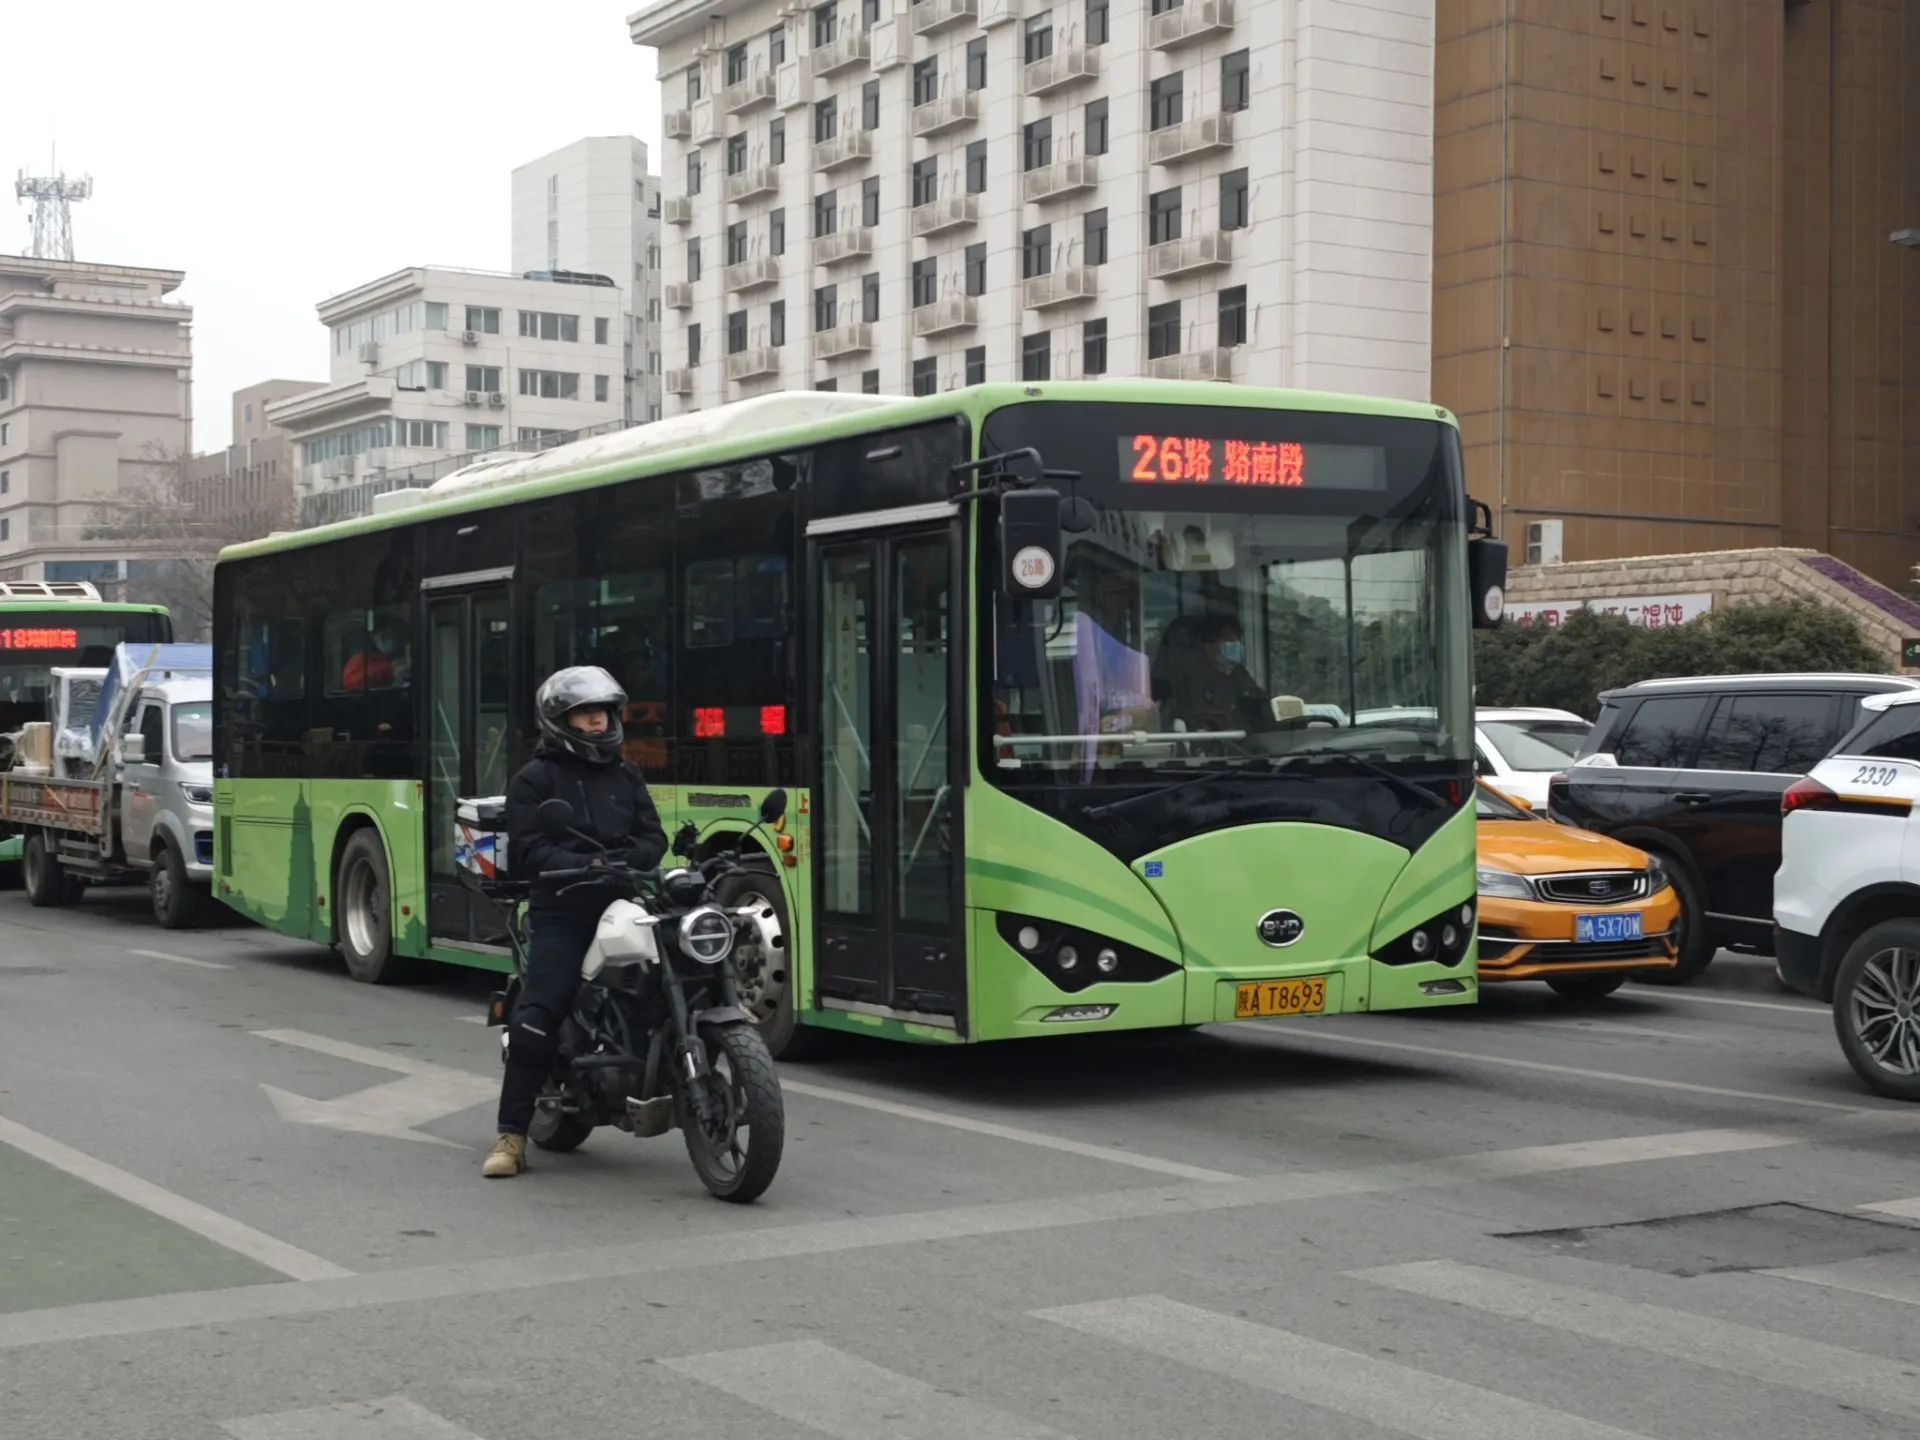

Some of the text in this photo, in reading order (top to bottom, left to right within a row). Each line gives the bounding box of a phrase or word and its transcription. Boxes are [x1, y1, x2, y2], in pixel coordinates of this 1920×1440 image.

[1132, 434, 1304, 486] 26路 路南段
[1021, 558, 1045, 577] 26路
[1850, 765, 1898, 787] 2330
[1263, 920, 1300, 936] BYD
[1268, 983, 1324, 1010] T8693
